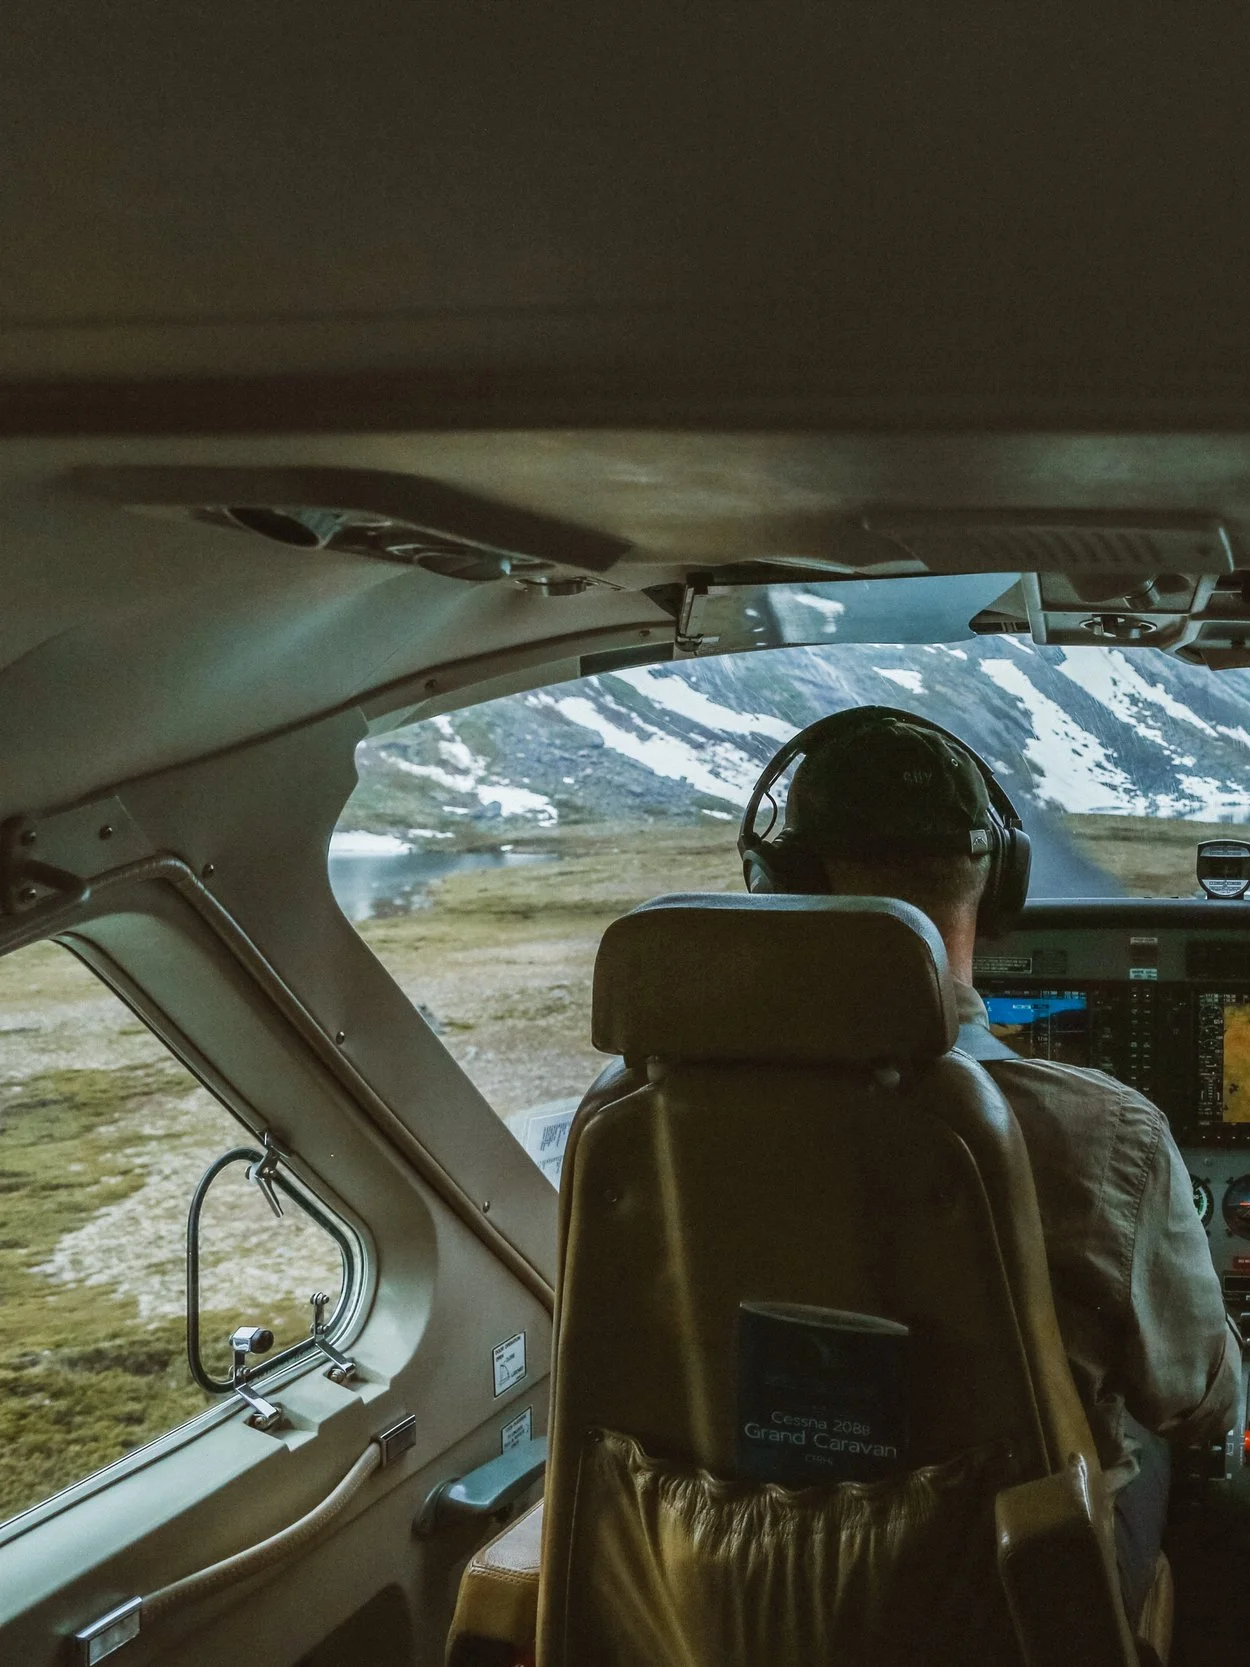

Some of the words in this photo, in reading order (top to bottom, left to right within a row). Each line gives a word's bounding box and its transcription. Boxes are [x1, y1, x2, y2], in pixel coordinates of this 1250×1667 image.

[771, 1410, 828, 1430] Cessna
[744, 1422, 806, 1446] Grand
[813, 1433, 897, 1460] Caravan
